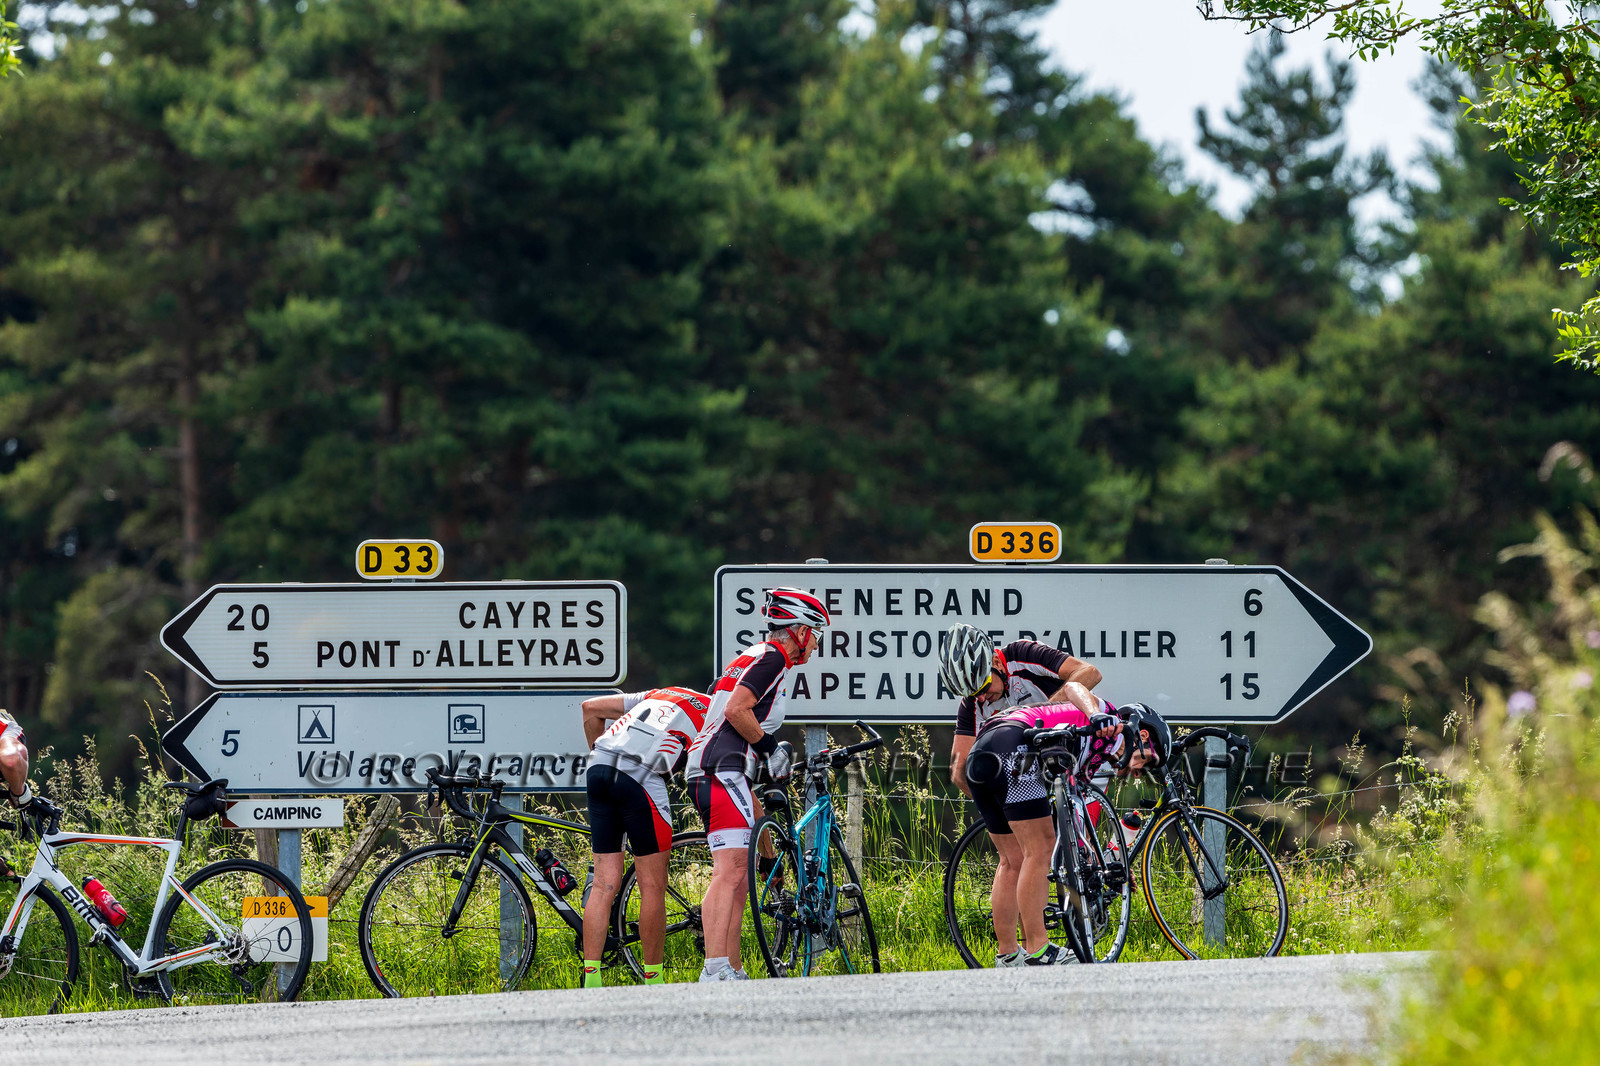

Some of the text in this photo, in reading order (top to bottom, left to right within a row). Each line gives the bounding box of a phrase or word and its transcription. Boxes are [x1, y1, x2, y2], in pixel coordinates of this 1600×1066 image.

[978, 532, 1054, 553] D 336
[364, 546, 433, 573] D 33
[808, 588, 1022, 616] ENERAND
[1243, 588, 1263, 616] 6
[227, 601, 604, 631] 20 CAYRES
[252, 641, 270, 668] 5
[317, 641, 400, 668] PONT
[1220, 631, 1256, 657] 11
[1221, 673, 1260, 700] 15
[221, 730, 241, 757] 5
[298, 750, 417, 785] Village
[254, 806, 322, 820] CAMPING
[254, 901, 286, 915] D 336
[278, 926, 292, 952] 0
